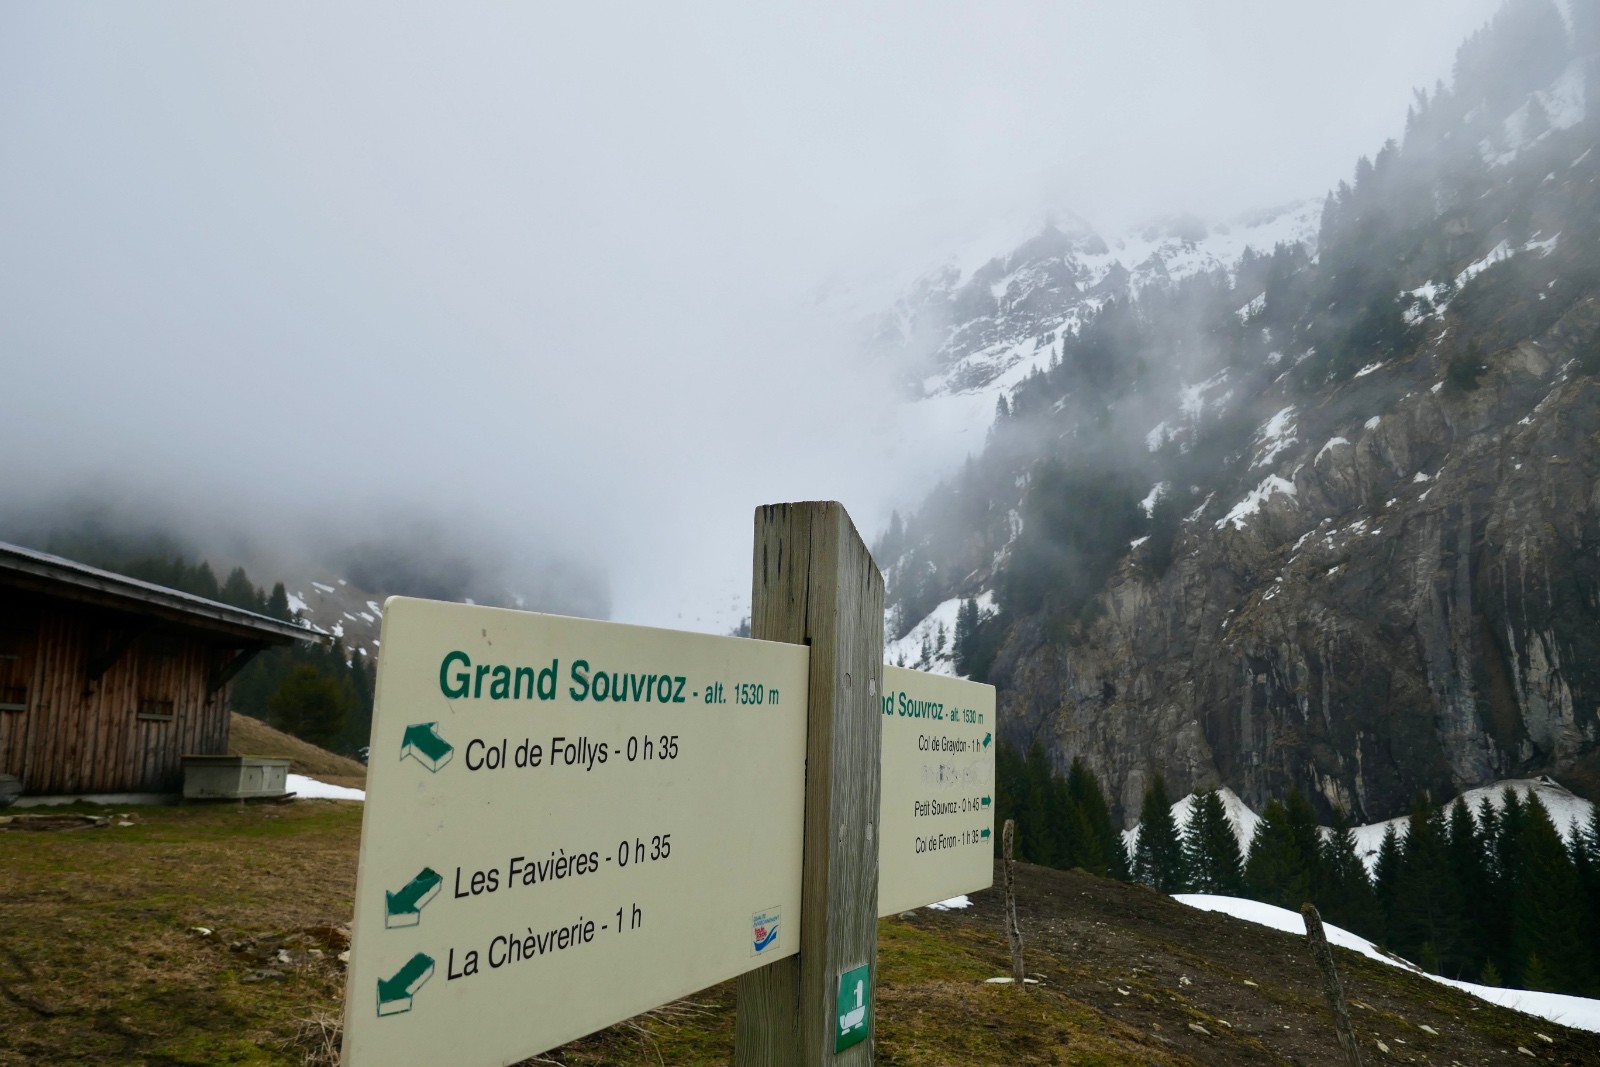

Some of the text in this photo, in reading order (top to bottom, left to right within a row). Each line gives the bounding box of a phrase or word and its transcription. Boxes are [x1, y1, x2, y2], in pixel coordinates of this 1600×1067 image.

[439, 650, 558, 702] Grand
[569, 659, 687, 704] Souvroz
[705, 681, 726, 705] alt.
[733, 683, 764, 706] 1530
[768, 688, 780, 705] m
[898, 692, 944, 720] Souvroz
[950, 707, 961, 722] alt.
[963, 709, 977, 724] 1530
[978, 713, 984, 725] m
[465, 737, 507, 772] Col
[515, 736, 542, 769] de
[550, 736, 609, 772] Follys
[626, 735, 638, 762] 0
[643, 734, 653, 761] h
[658, 734, 679, 760] 35
[918, 735, 931, 752] Col
[931, 736, 940, 752] de
[941, 736, 967, 756] Graydon
[972, 739, 975, 753] 1
[976, 739, 981, 753] h
[914, 800, 930, 817] Petit
[931, 799, 957, 816] Souvroz
[962, 798, 967, 812] 0
[967, 797, 972, 812] h
[972, 797, 980, 812] 45
[915, 837, 927, 854] Col
[928, 835, 937, 852] de
[938, 833, 957, 850] Foron
[962, 831, 965, 846] 1
[966, 830, 971, 845] h
[971, 829, 979, 844] 35
[454, 866, 499, 899] Les
[508, 848, 599, 889] Favières
[617, 840, 629, 868] 0
[634, 838, 645, 864] h
[650, 834, 671, 861] 35
[447, 947, 479, 981] La
[488, 916, 595, 969] Chèvrerie
[615, 906, 623, 933] 1
[631, 902, 642, 930] h
